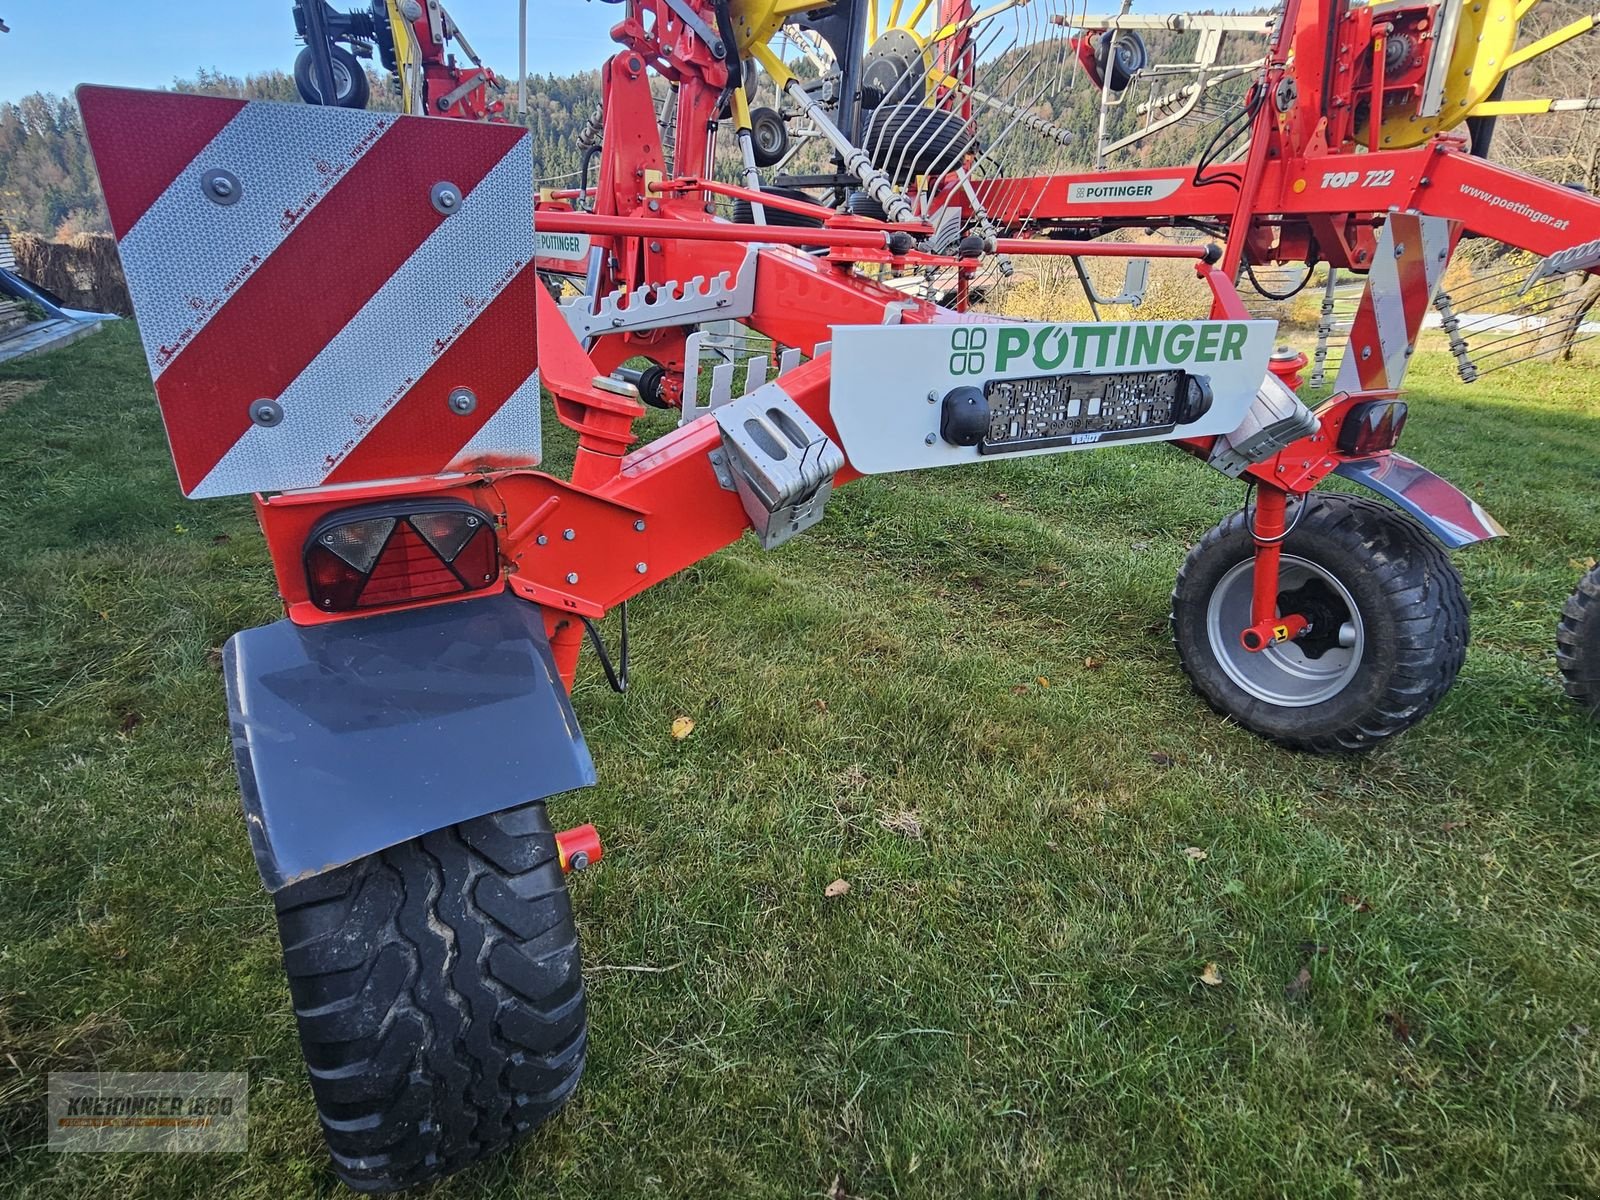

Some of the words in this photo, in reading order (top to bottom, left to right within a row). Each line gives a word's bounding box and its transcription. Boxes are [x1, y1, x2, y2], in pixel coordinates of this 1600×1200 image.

[1320, 172, 1359, 189] TOP
[1361, 169, 1395, 188] 722
[1459, 182, 1570, 231] www.poettinger.at
[1071, 432, 1102, 444] FENDT
